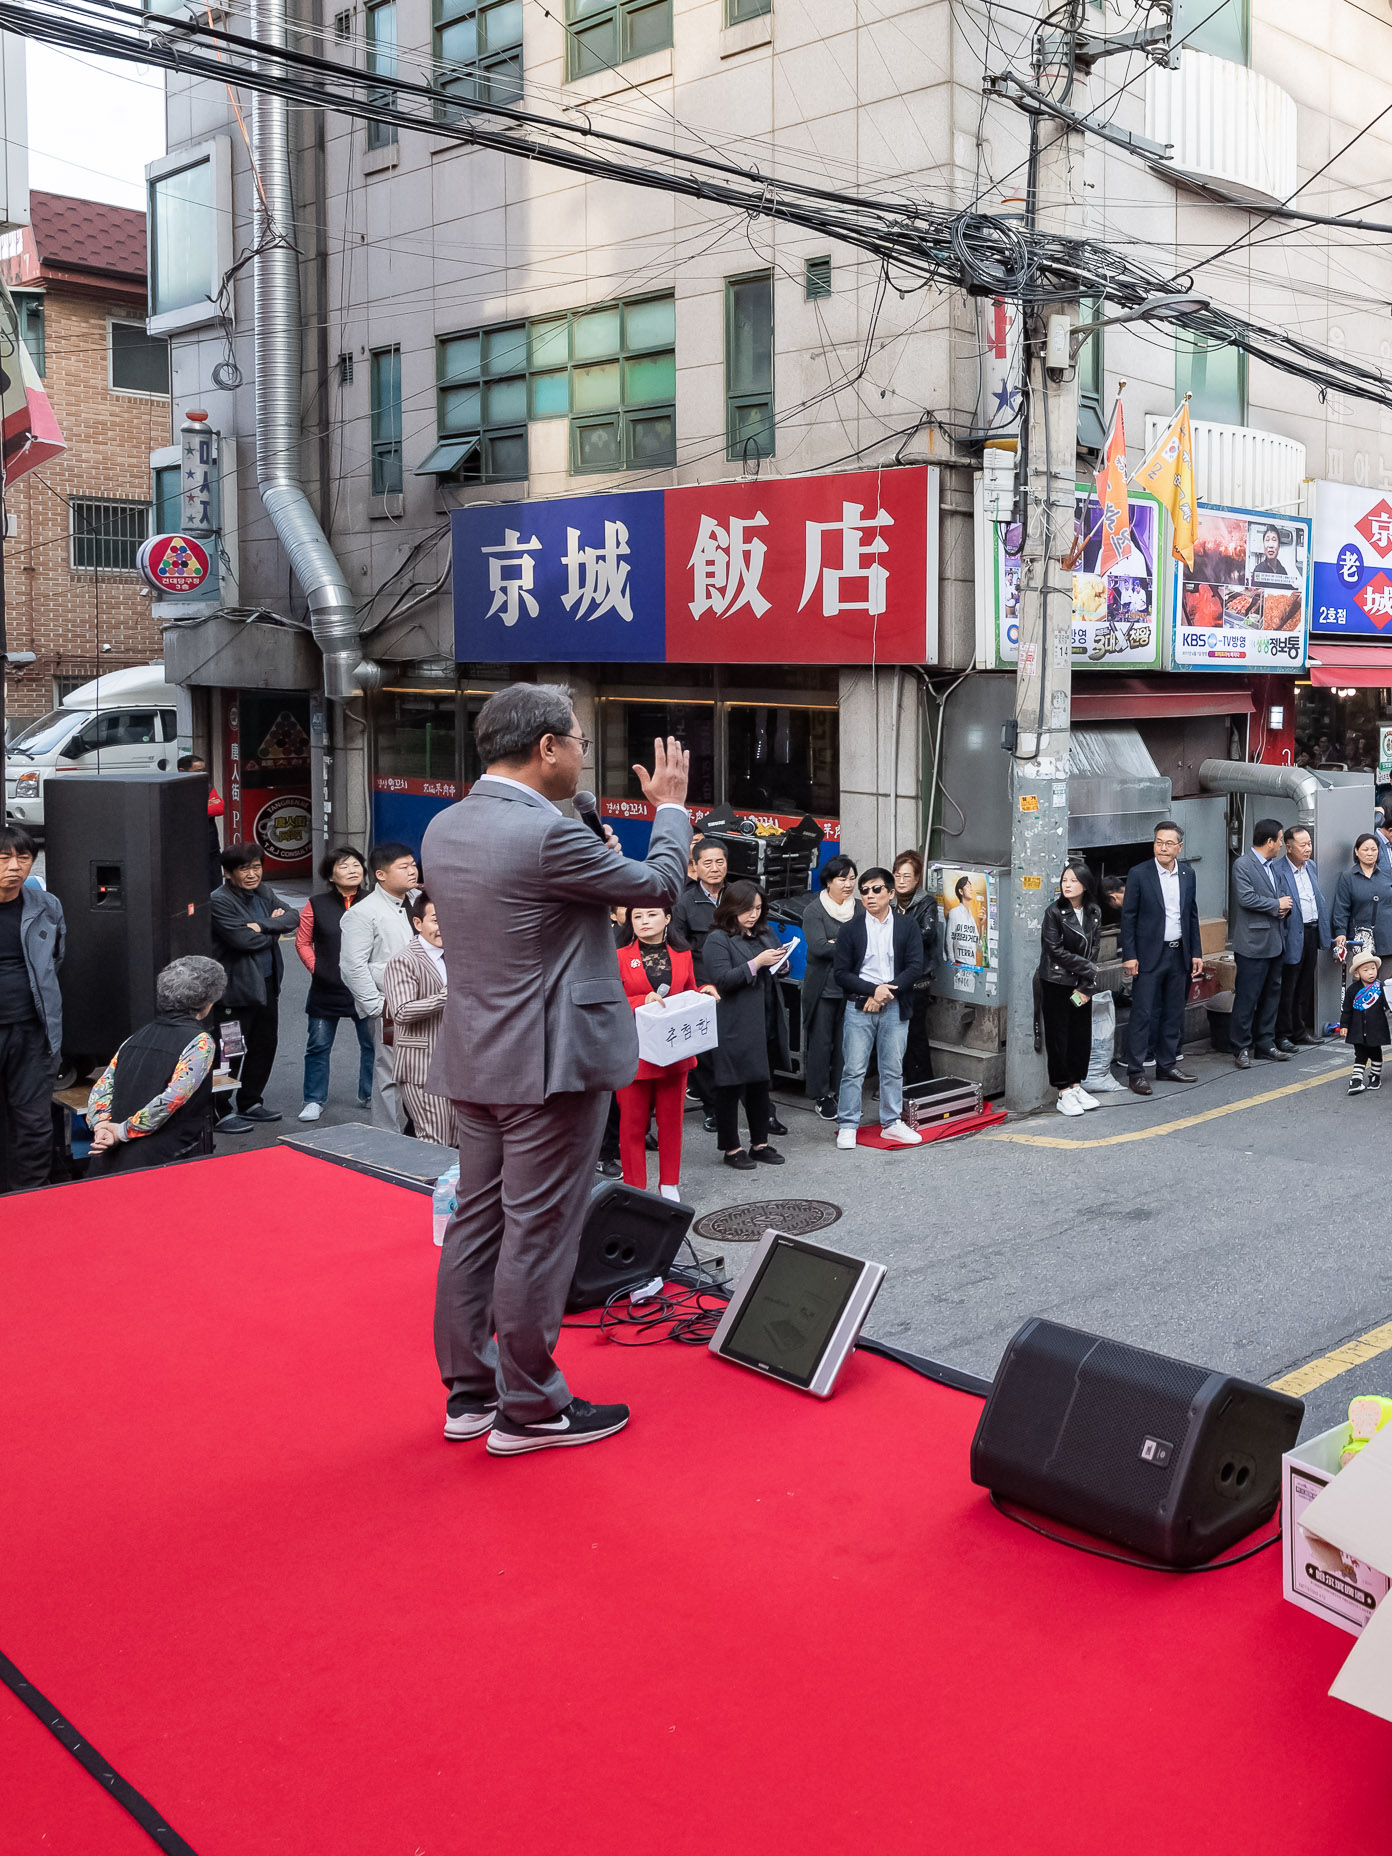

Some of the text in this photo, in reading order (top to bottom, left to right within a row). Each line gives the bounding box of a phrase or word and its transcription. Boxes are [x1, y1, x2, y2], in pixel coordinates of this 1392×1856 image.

[1338, 550, 1361, 583] 老
[1318, 606, 1347, 625] 2호점
[1183, 633, 1207, 647] KBS
[620, 801, 648, 817] 양꼬치
[957, 947, 975, 958] TERRA
[665, 1017, 711, 1048] 추첨함
